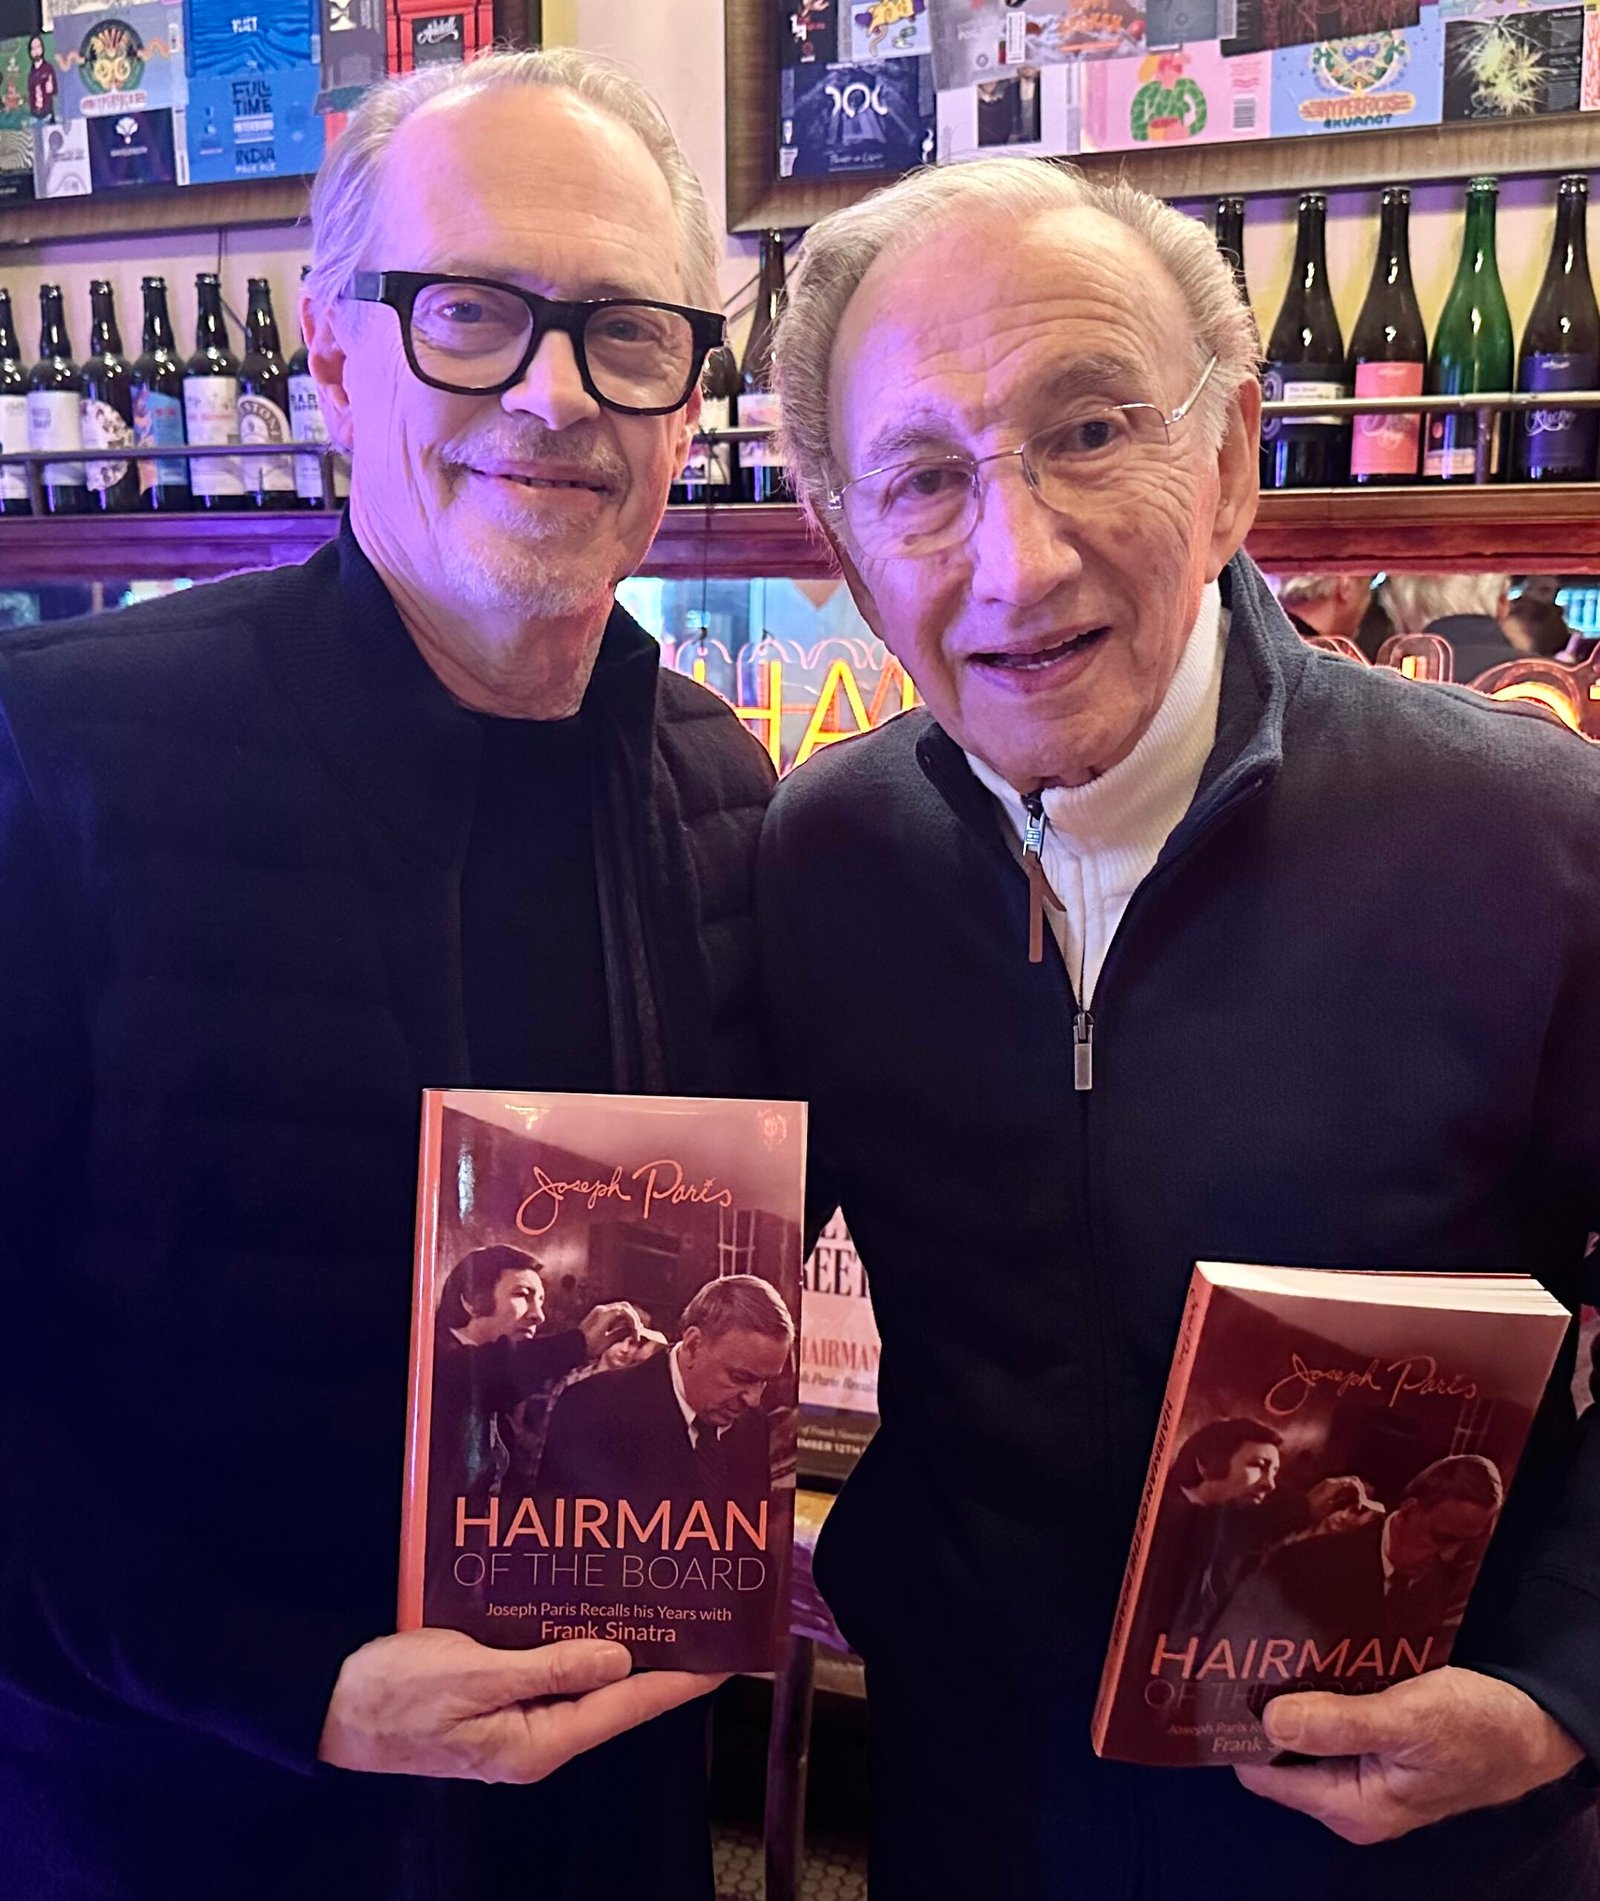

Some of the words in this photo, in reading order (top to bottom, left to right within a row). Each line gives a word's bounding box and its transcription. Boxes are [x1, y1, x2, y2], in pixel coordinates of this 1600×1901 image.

[232, 80, 273, 99] FULL
[233, 99, 273, 116] TIME
[235, 147, 276, 166] INDIA
[515, 1165, 631, 1236] Joseph
[632, 1159, 732, 1219] Paris
[1264, 1352, 1381, 1416] Joseph
[1387, 1355, 1478, 1408] Paris
[1144, 1397, 1173, 1502] HAIRMAN
[455, 1497, 768, 1552] HAIRMAN
[453, 1553, 513, 1587] OF
[522, 1553, 607, 1588] THE
[622, 1555, 766, 1591] BOARD
[486, 1602, 538, 1619] Joseph
[540, 1603, 577, 1617] Paris
[580, 1603, 631, 1618] Recalls
[633, 1605, 654, 1619] his
[657, 1605, 697, 1621] Years
[699, 1607, 732, 1622] with
[541, 1621, 599, 1640] Frank
[605, 1621, 677, 1643] Sinatra
[1150, 1634, 1434, 1681] HAIRMAN
[1144, 1679, 1200, 1711] OF
[1168, 1722, 1214, 1737] Joseph
[1215, 1721, 1247, 1734] Paris
[1211, 1736, 1262, 1753] Frank
